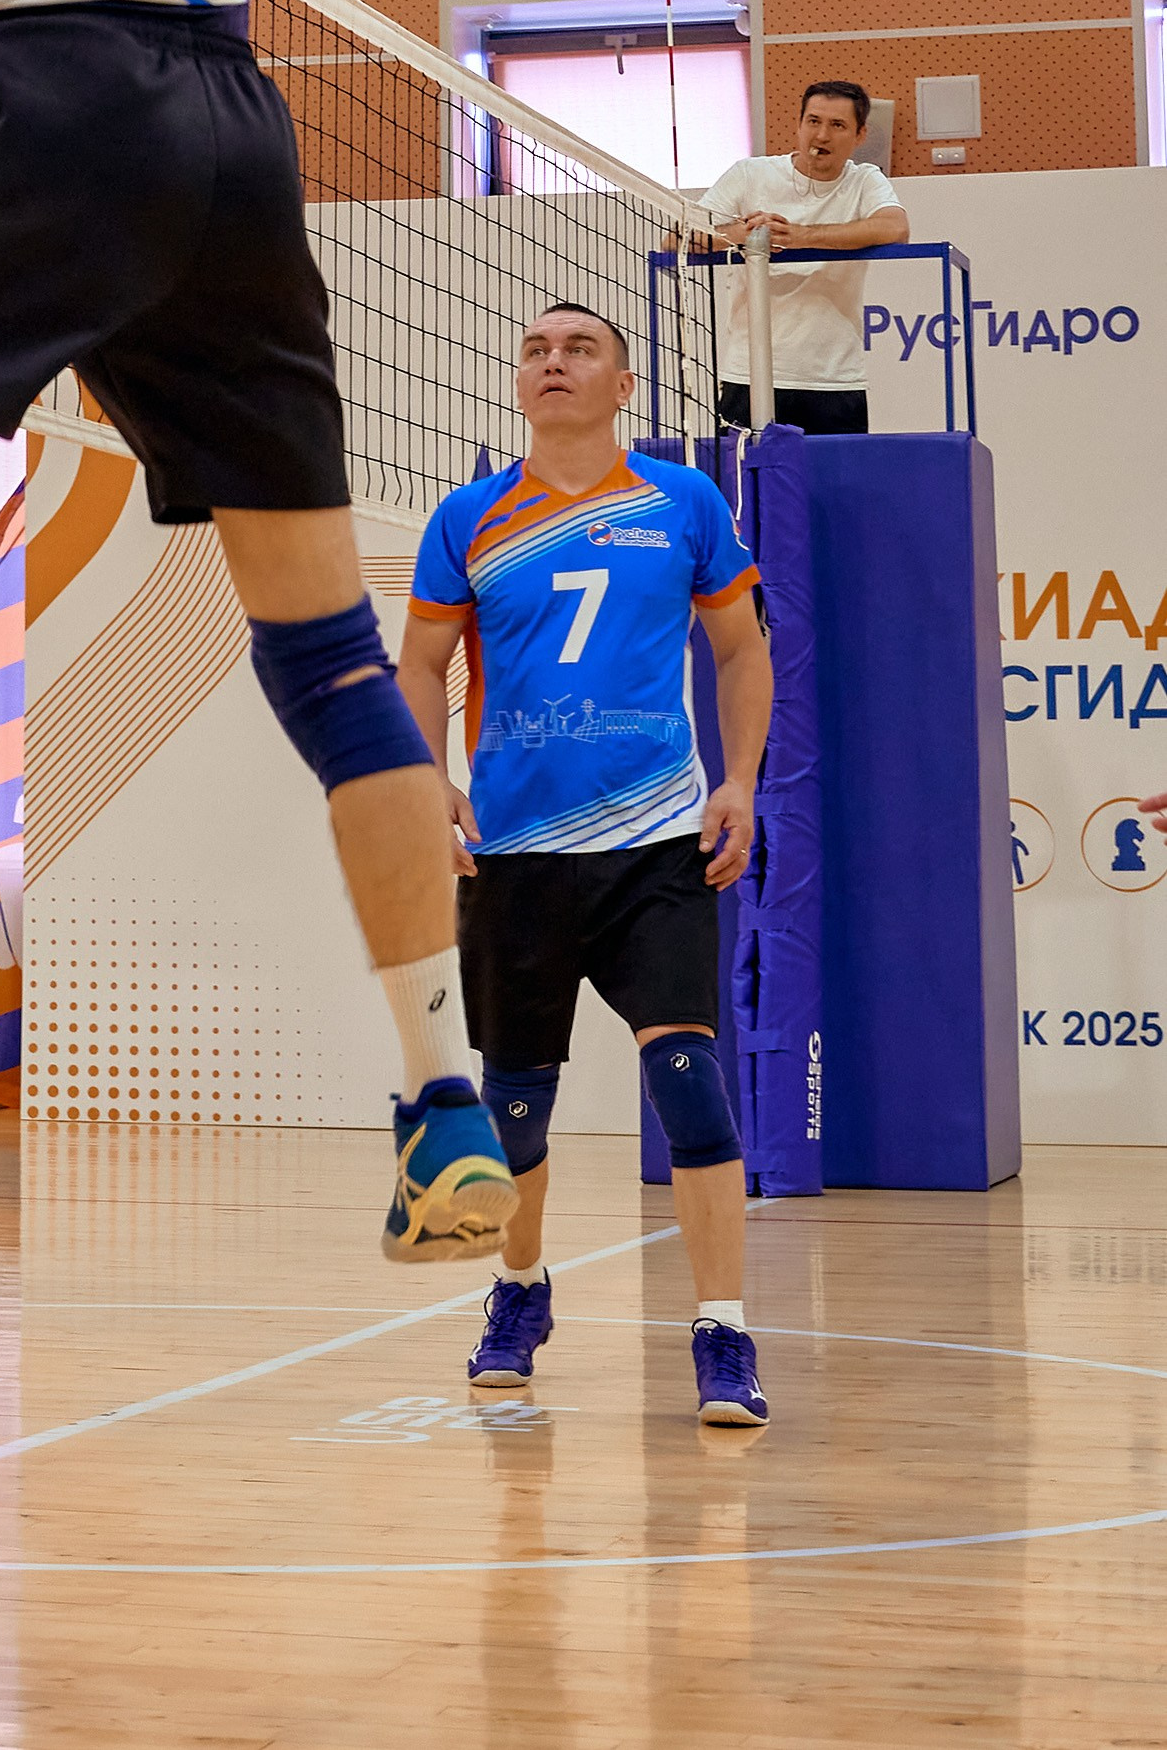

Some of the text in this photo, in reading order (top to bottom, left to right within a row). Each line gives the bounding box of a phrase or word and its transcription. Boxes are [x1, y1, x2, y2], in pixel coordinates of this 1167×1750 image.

[552, 568, 610, 663] 7
[997, 570, 1167, 650] ИА
[1062, 1010, 1164, 1047] 2025
